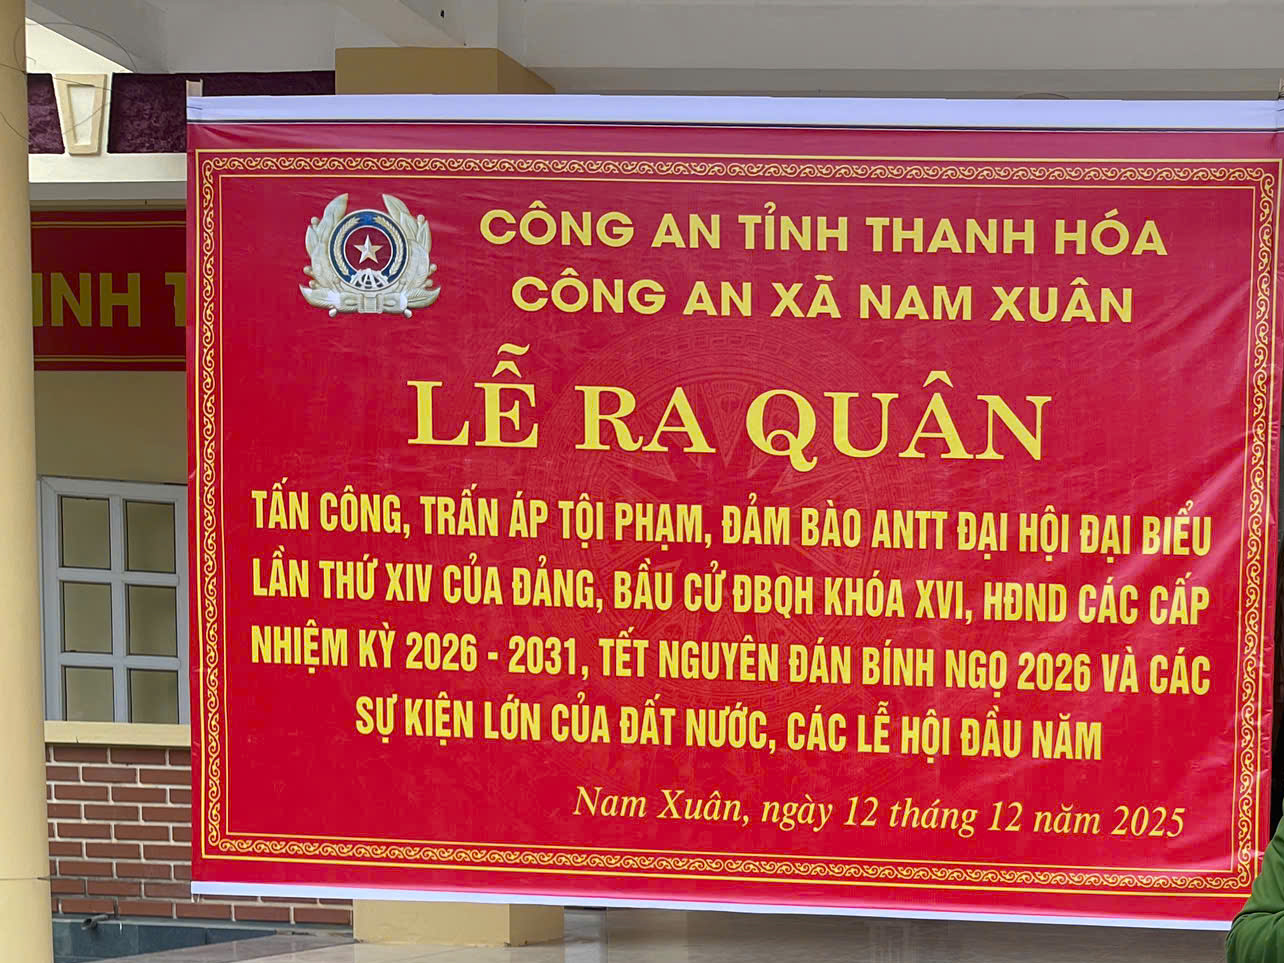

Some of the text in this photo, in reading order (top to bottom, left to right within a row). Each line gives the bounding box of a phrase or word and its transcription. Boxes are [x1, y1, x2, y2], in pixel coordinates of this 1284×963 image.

[479, 200, 1168, 256] CÔNG AN TỈNH THANH HÓA
[511, 267, 1133, 323] CÔNG AN XÃ NAM XUÂN
[407, 343, 1052, 473] LỄ RA QUÂN
[251, 477, 1212, 564] TẤN CÔNG, TRẤN ÁP TỘI PHẠM, ĐẢM BÀO ANTT ĐẠI HỘI ĐẠI BIỂU
[252, 545, 1210, 625] LẦN THỨ XIV CỦA ĐẢNG, BẦU CỬ ĐBQH KHÓA XVI, HĐND CÁC CẤP
[251, 618, 1211, 698] NHIỆM KỲ 2026 - 2031, TẾT NGUYÊN ĐÁN BÍNH NGỌ 2026 VÀ CÁC
[355, 691, 1102, 764] SỰ KIỆN LỚN CỦA ĐẤT NƯỚC, CÁC LỄ HỘI ĐẦU NĂM
[572, 785, 1186, 839] Nam Xuân, ngày 12 tháng 12 năm 2025
